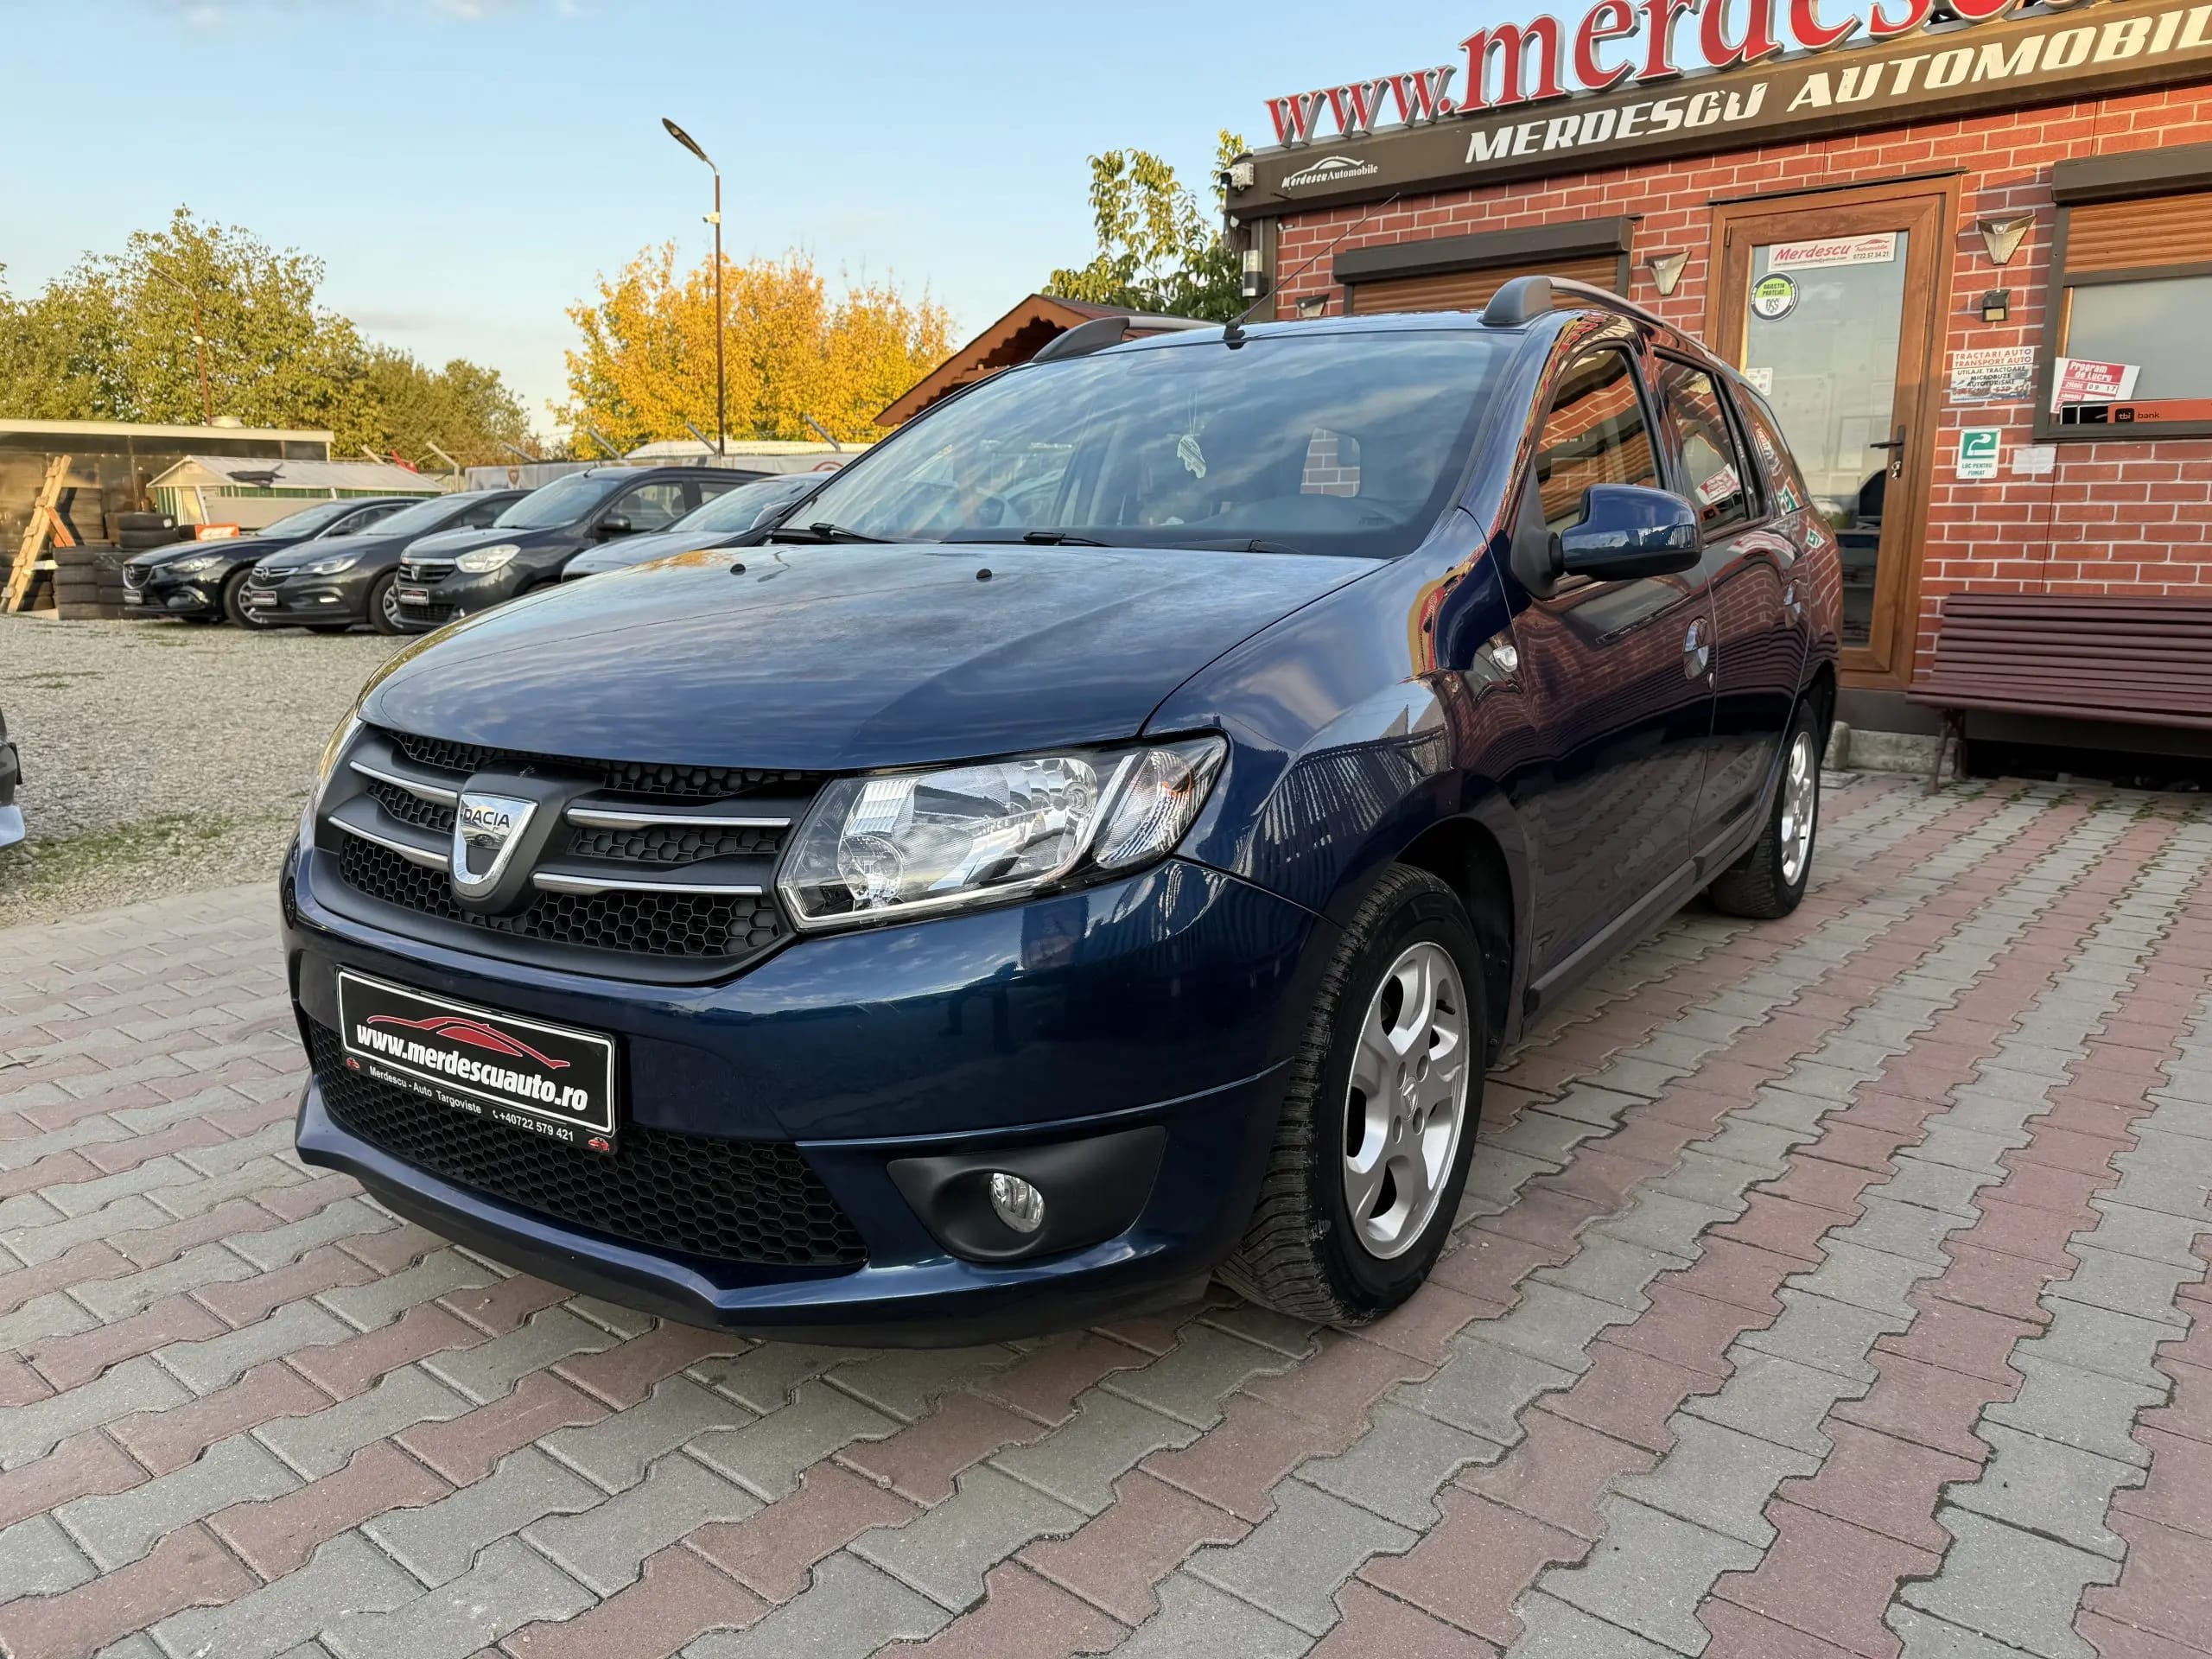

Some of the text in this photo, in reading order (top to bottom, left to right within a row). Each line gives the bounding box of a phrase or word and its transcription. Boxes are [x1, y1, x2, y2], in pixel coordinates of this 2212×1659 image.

[1465, 82, 1768, 163] MERDESCU
[1774, 245, 1851, 261] Merdescu
[1955, 348, 2031, 360] TRACTARI AUTO
[1955, 358, 2005, 367] TRANSPORT
[2069, 361, 2108, 374] Program
[2075, 370, 2085, 378] de
[2138, 410, 2160, 419] bank
[463, 808, 510, 829] DACIA
[356, 1023, 588, 1111] www.merdescuauto.ro
[369, 1065, 407, 1088] Merdescu
[413, 1082, 433, 1097] Auto
[435, 1090, 482, 1114] Targoviste
[499, 1111, 574, 1141] +40722 579 421
